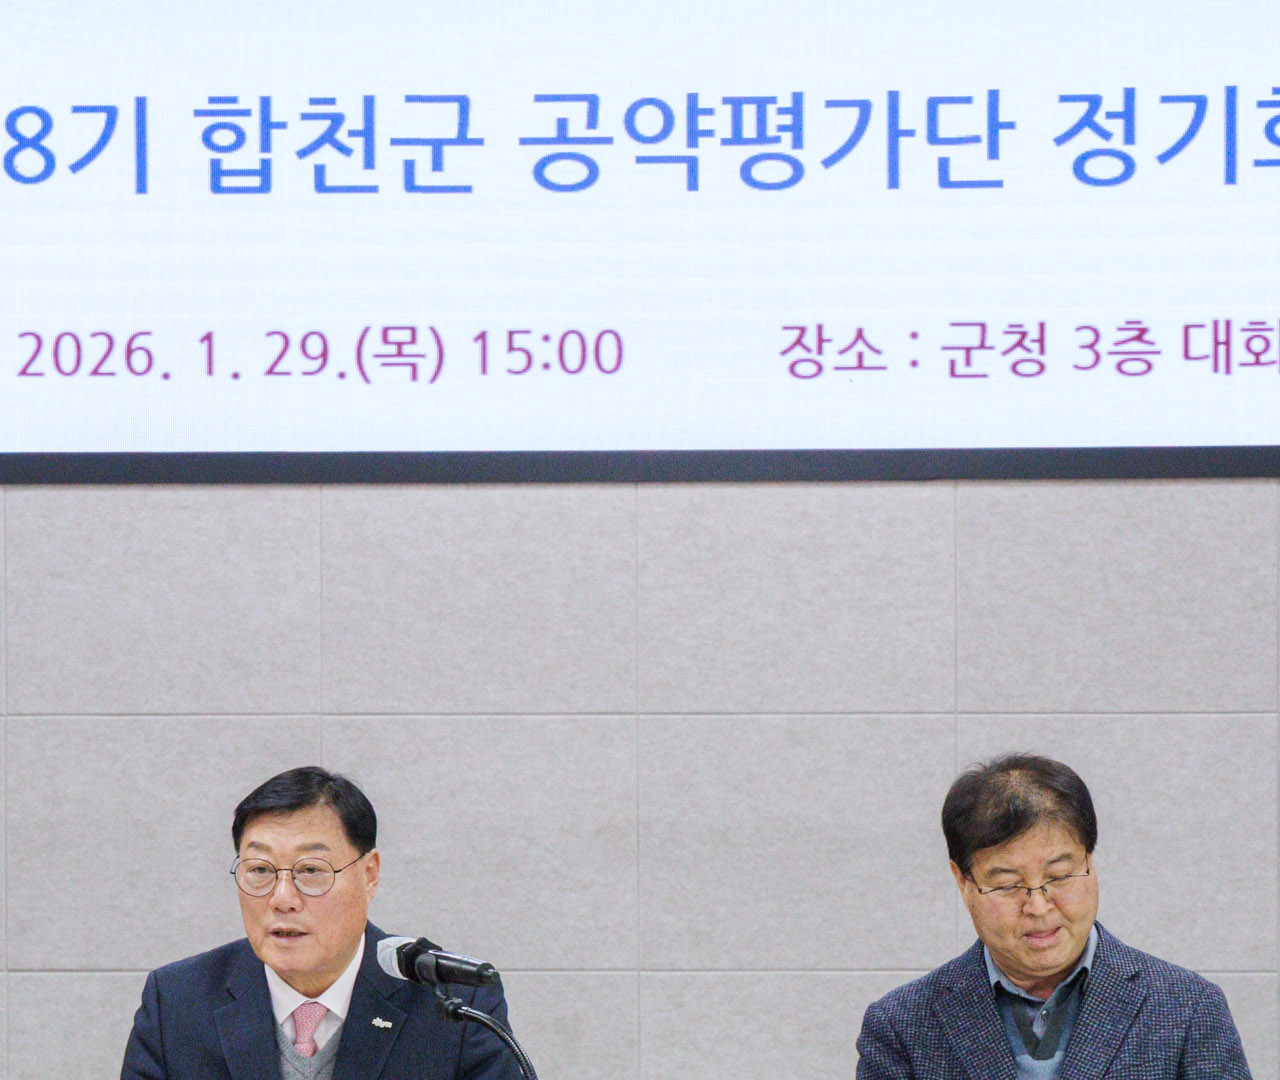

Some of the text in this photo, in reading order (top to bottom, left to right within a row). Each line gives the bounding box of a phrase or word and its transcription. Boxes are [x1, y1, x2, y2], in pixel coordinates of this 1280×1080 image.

[193, 94, 486, 195] 합천군
[519, 88, 1018, 193] 공약평가단
[17, 331, 170, 380] 2026.
[199, 331, 240, 380] 1.
[265, 326, 445, 384] 29.(목)
[473, 329, 623, 375] 15:00
[779, 323, 888, 380] 장소
[940, 321, 1047, 379] 군청
[1072, 320, 1162, 377] 3층
